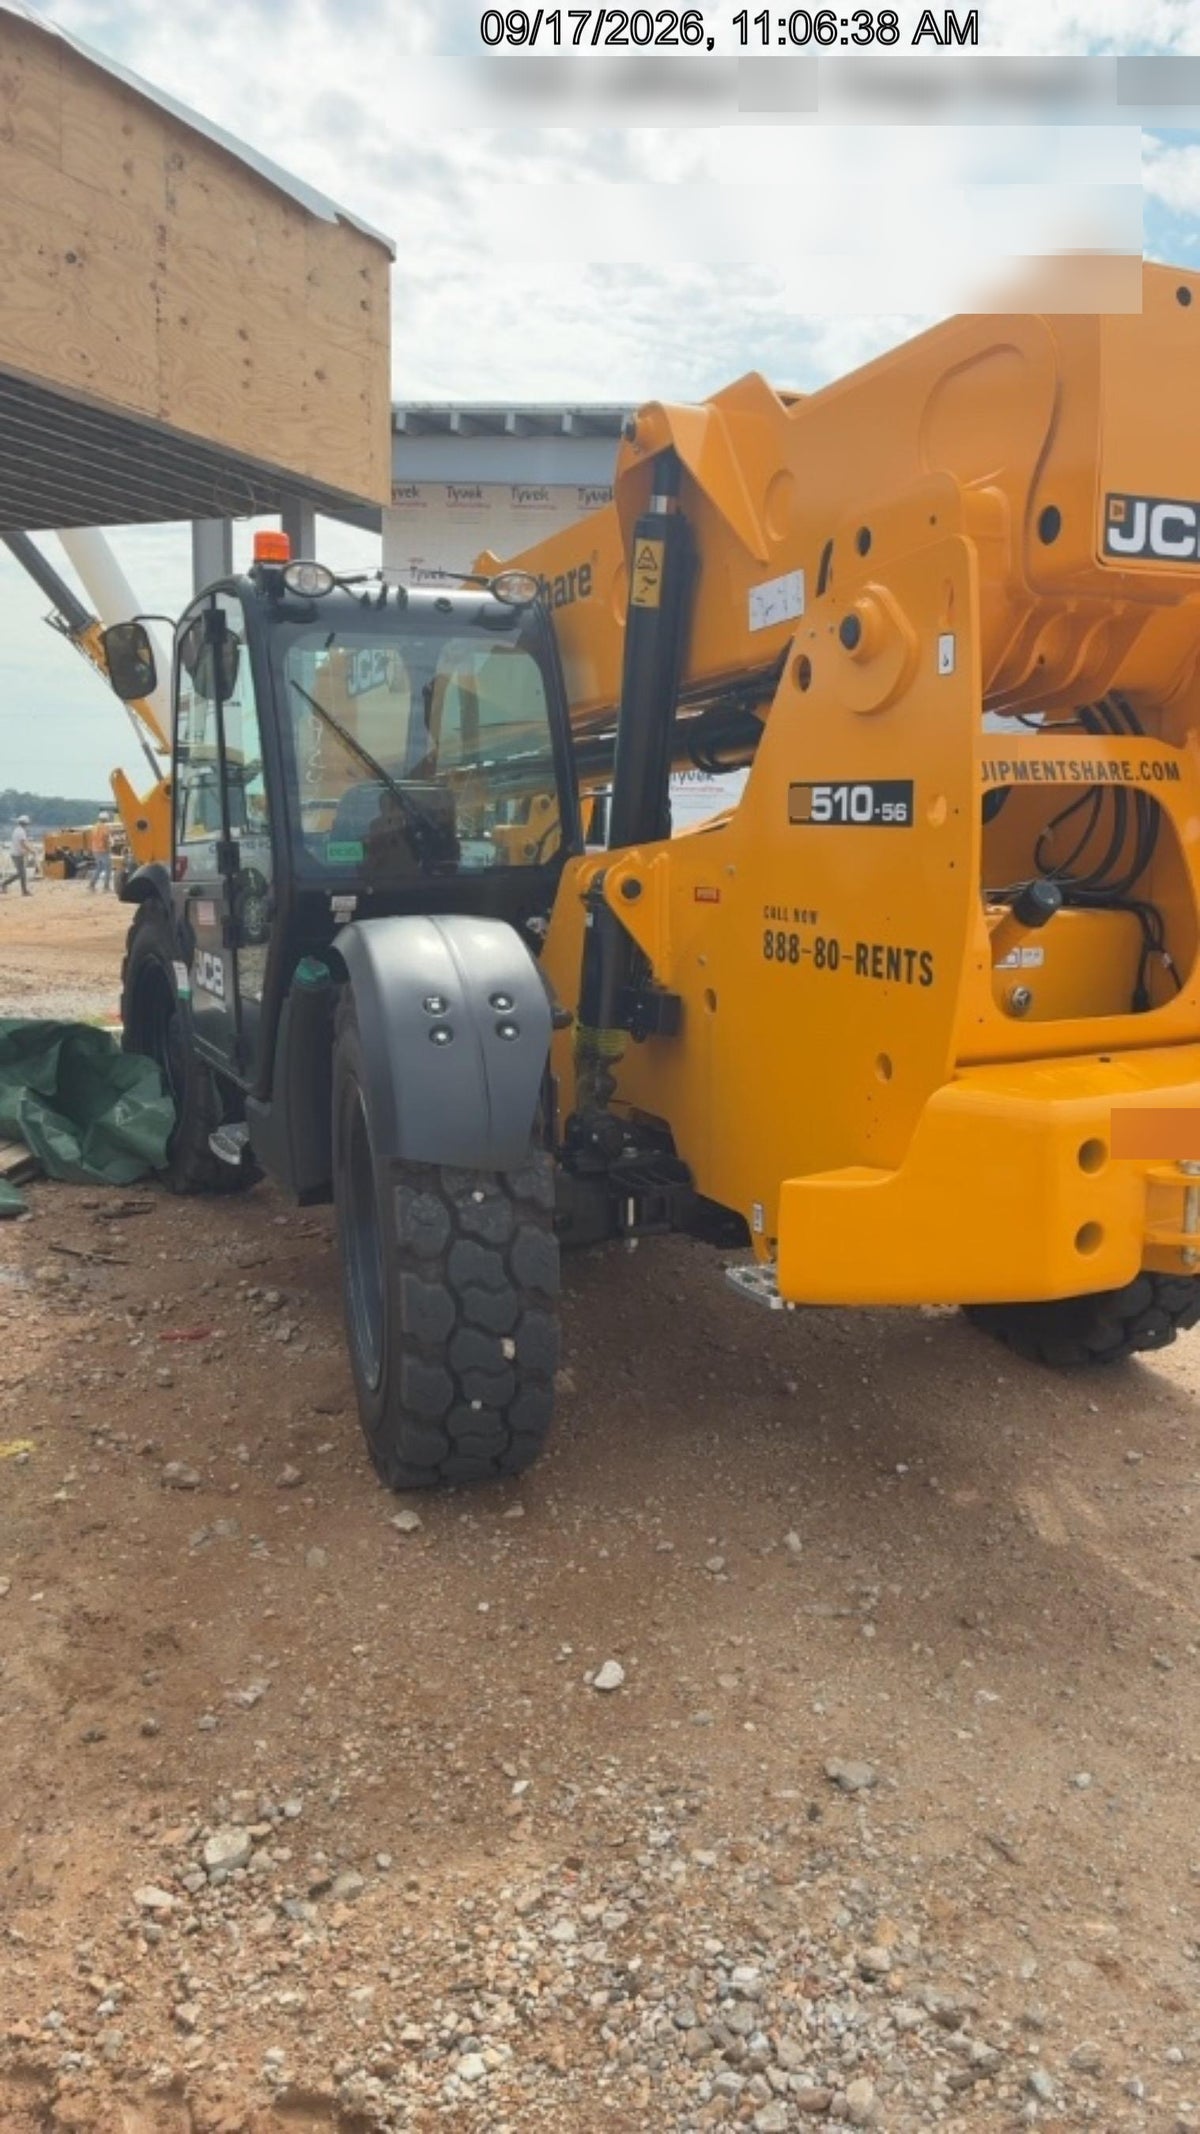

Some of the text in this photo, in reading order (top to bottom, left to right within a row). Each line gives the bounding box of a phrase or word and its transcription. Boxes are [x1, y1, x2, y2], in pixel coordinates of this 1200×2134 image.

[446, 484, 482, 502] Tyvek
[511, 485, 549, 503] Tyvek
[1108, 501, 1200, 558] JC
[763, 904, 819, 926] CALL NOW
[763, 929, 933, 988] 888-80-RENTS
